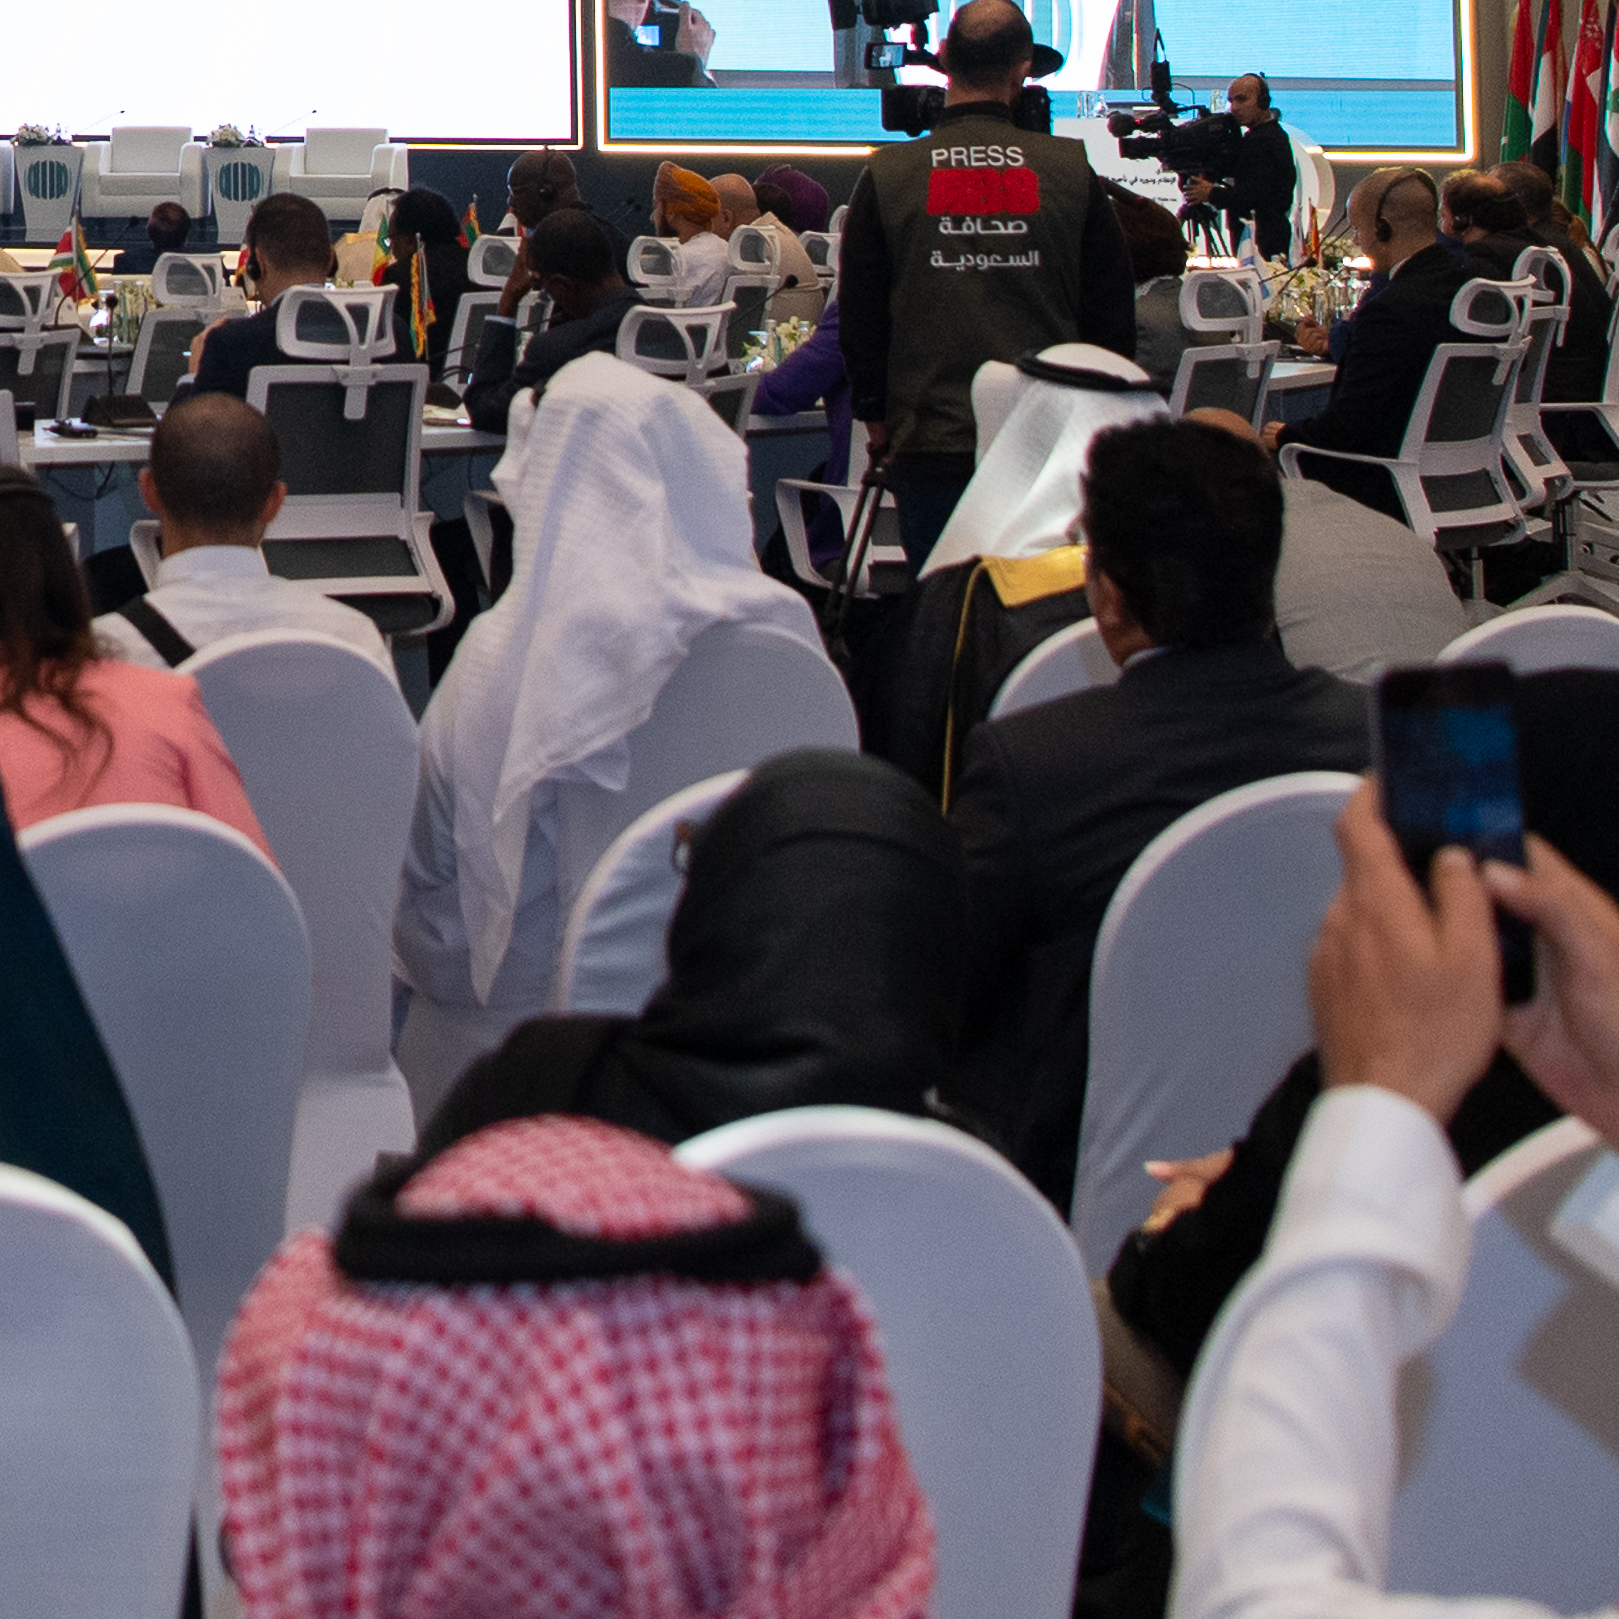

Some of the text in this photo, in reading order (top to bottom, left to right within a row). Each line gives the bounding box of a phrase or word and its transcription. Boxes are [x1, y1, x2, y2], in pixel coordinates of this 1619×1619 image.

[930, 144, 1025, 168] PRESS
[938, 215, 1029, 235] صحافة
[930, 249, 1041, 271] السعودية
